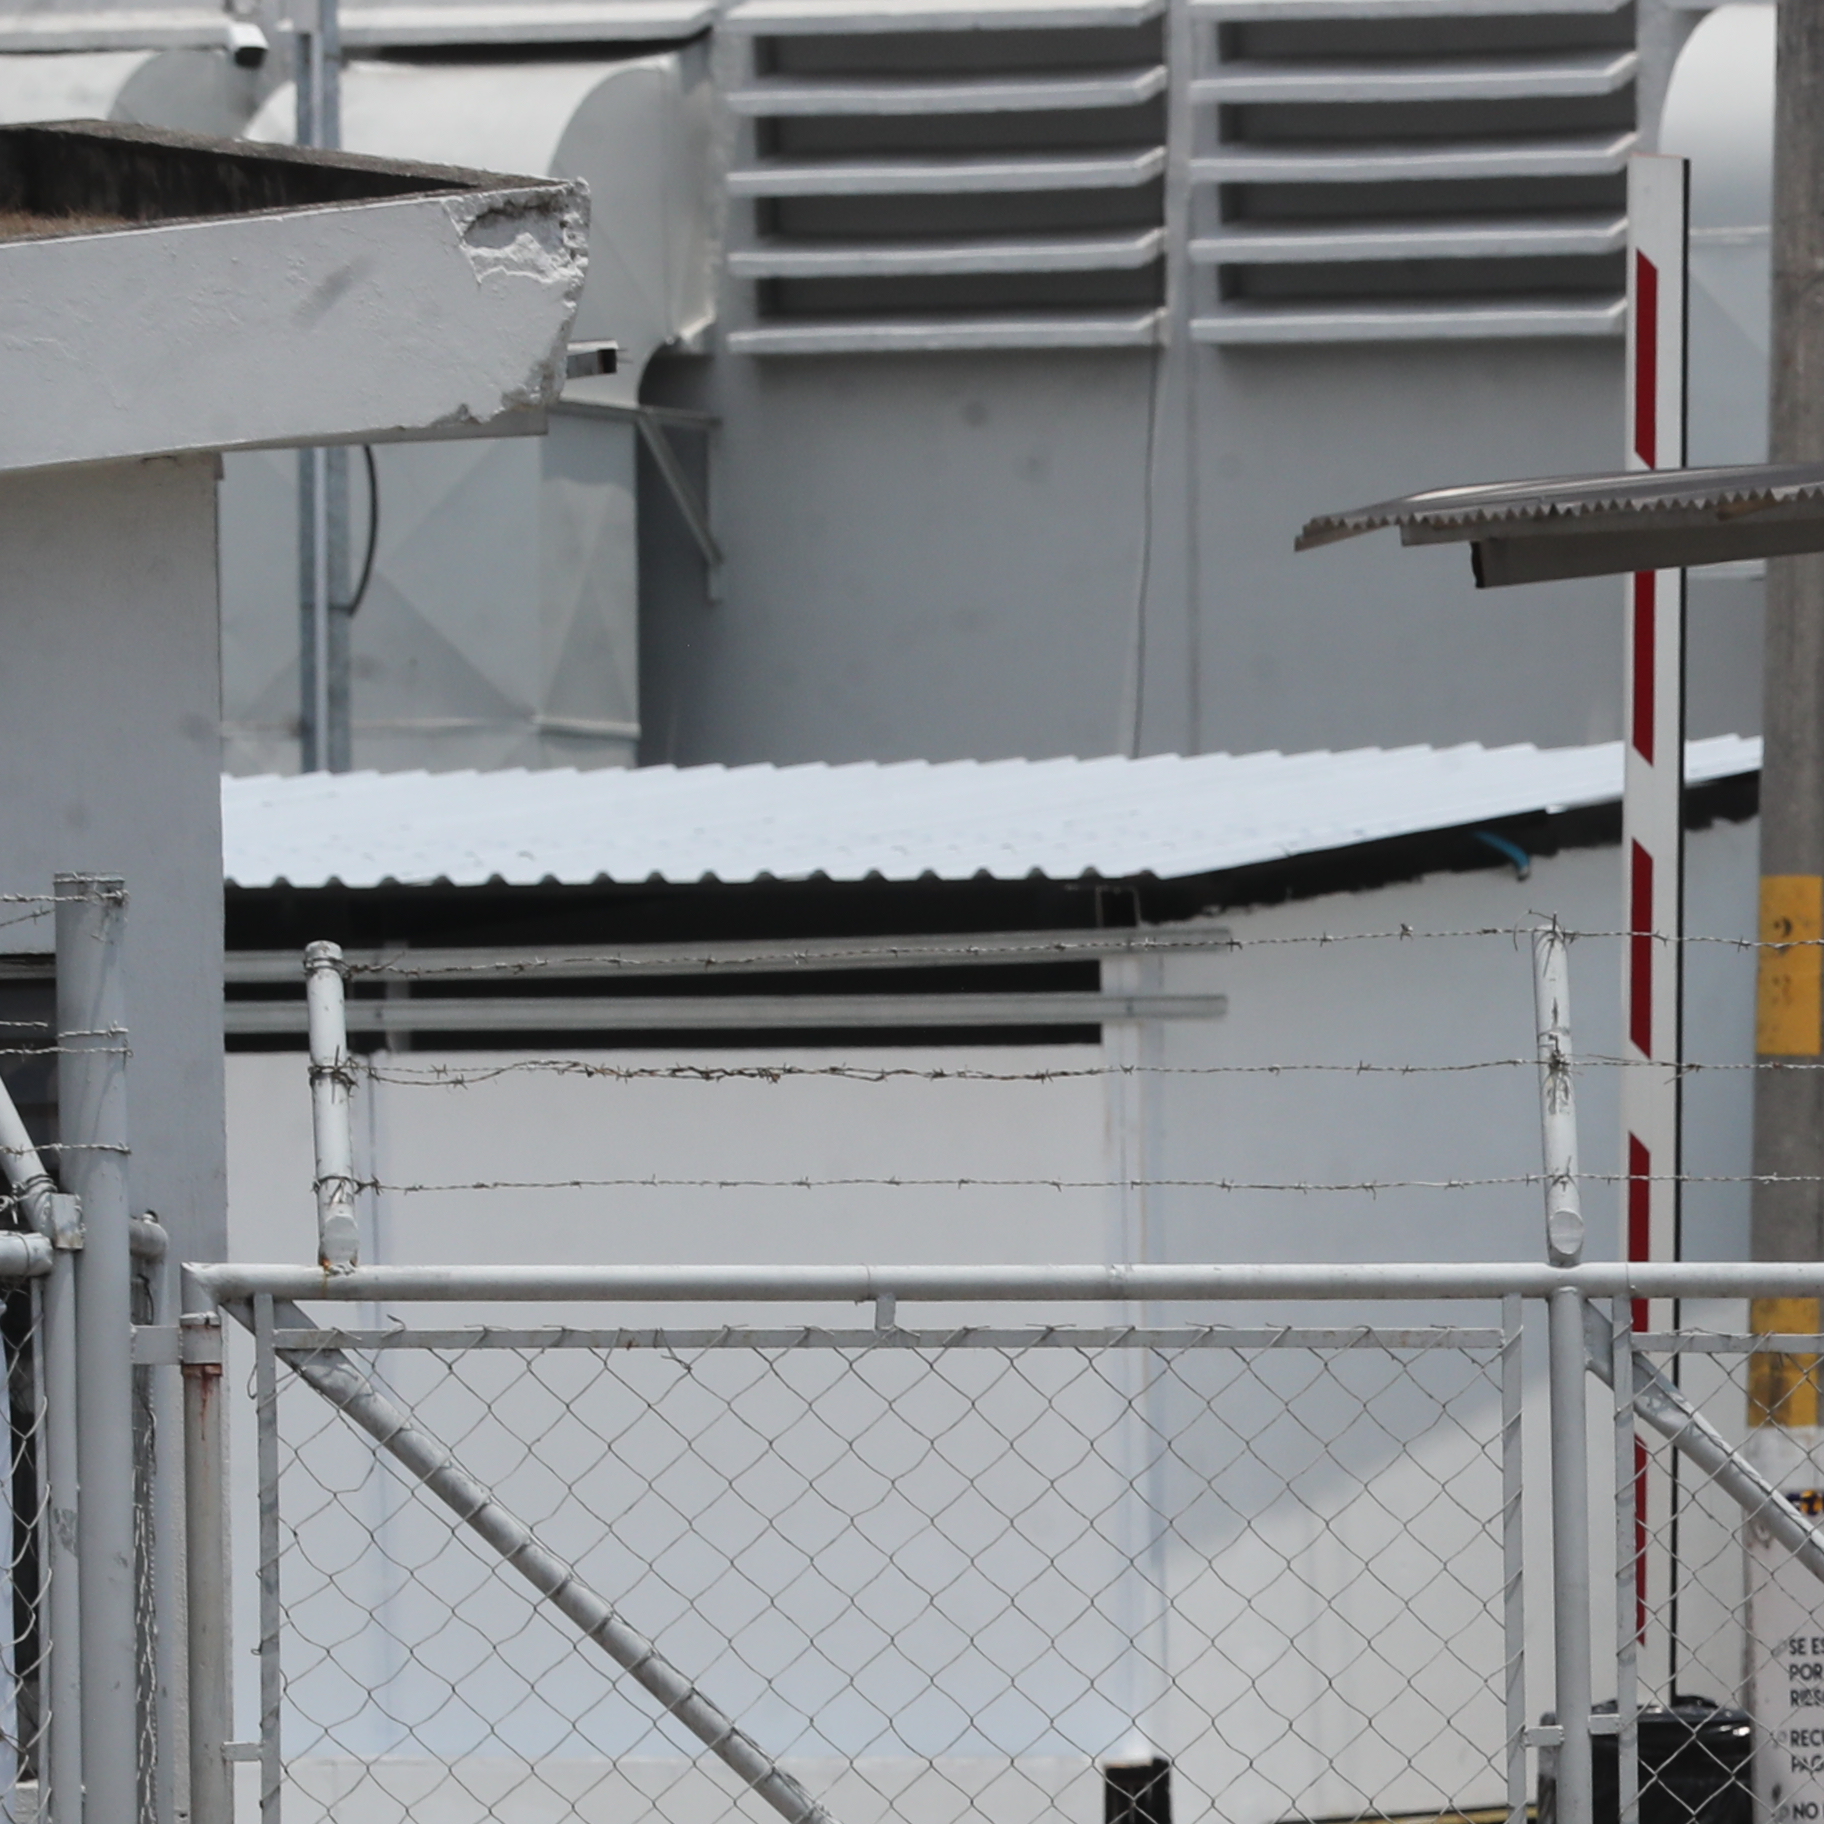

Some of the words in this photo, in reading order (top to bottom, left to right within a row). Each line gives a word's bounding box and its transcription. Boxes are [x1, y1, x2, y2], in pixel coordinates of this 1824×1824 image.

[1789, 1637, 1806, 1656] SE
[1789, 1663, 1823, 1681] POR
[1793, 1802, 1818, 1820] NO
